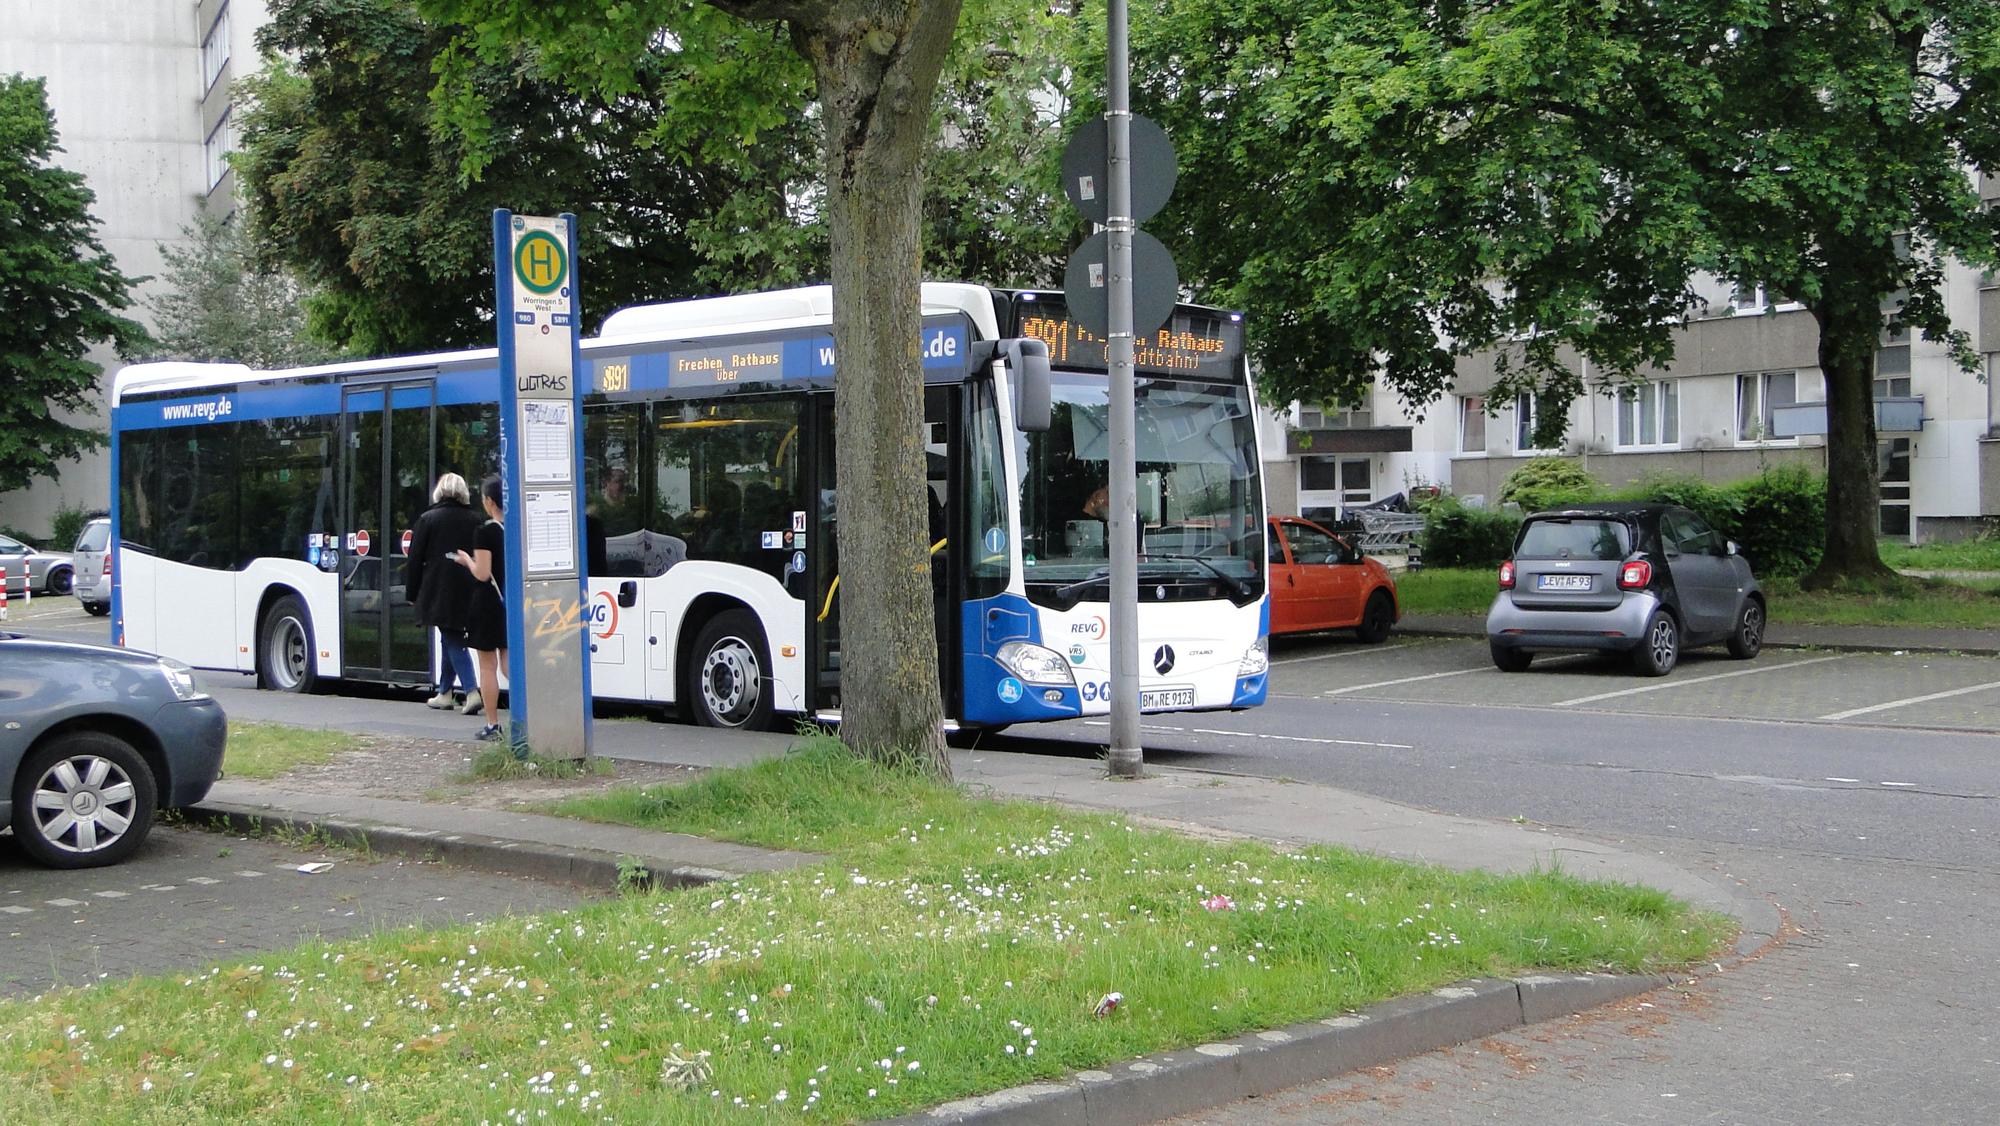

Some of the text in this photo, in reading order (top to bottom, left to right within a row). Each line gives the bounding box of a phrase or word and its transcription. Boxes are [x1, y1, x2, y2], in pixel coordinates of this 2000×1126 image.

[530, 244, 552, 281] H
[523, 296, 557, 305] Worringen
[535, 304, 552, 312] West
[519, 314, 532, 323] 980
[1158, 329, 1224, 353] Rathaus
[679, 353, 779, 371] Frechen Rathaus
[1103, 344, 1199, 369] (adtbahn)
[603, 364, 627, 391] SB91
[163, 396, 232, 421] www.revg.de
[1544, 577, 1590, 586] LEV AF 93
[588, 604, 606, 622] VG
[1071, 623, 1098, 633] REVG
[1069, 647, 1082, 655] VRS
[1142, 691, 1192, 707] BM RE 9123
